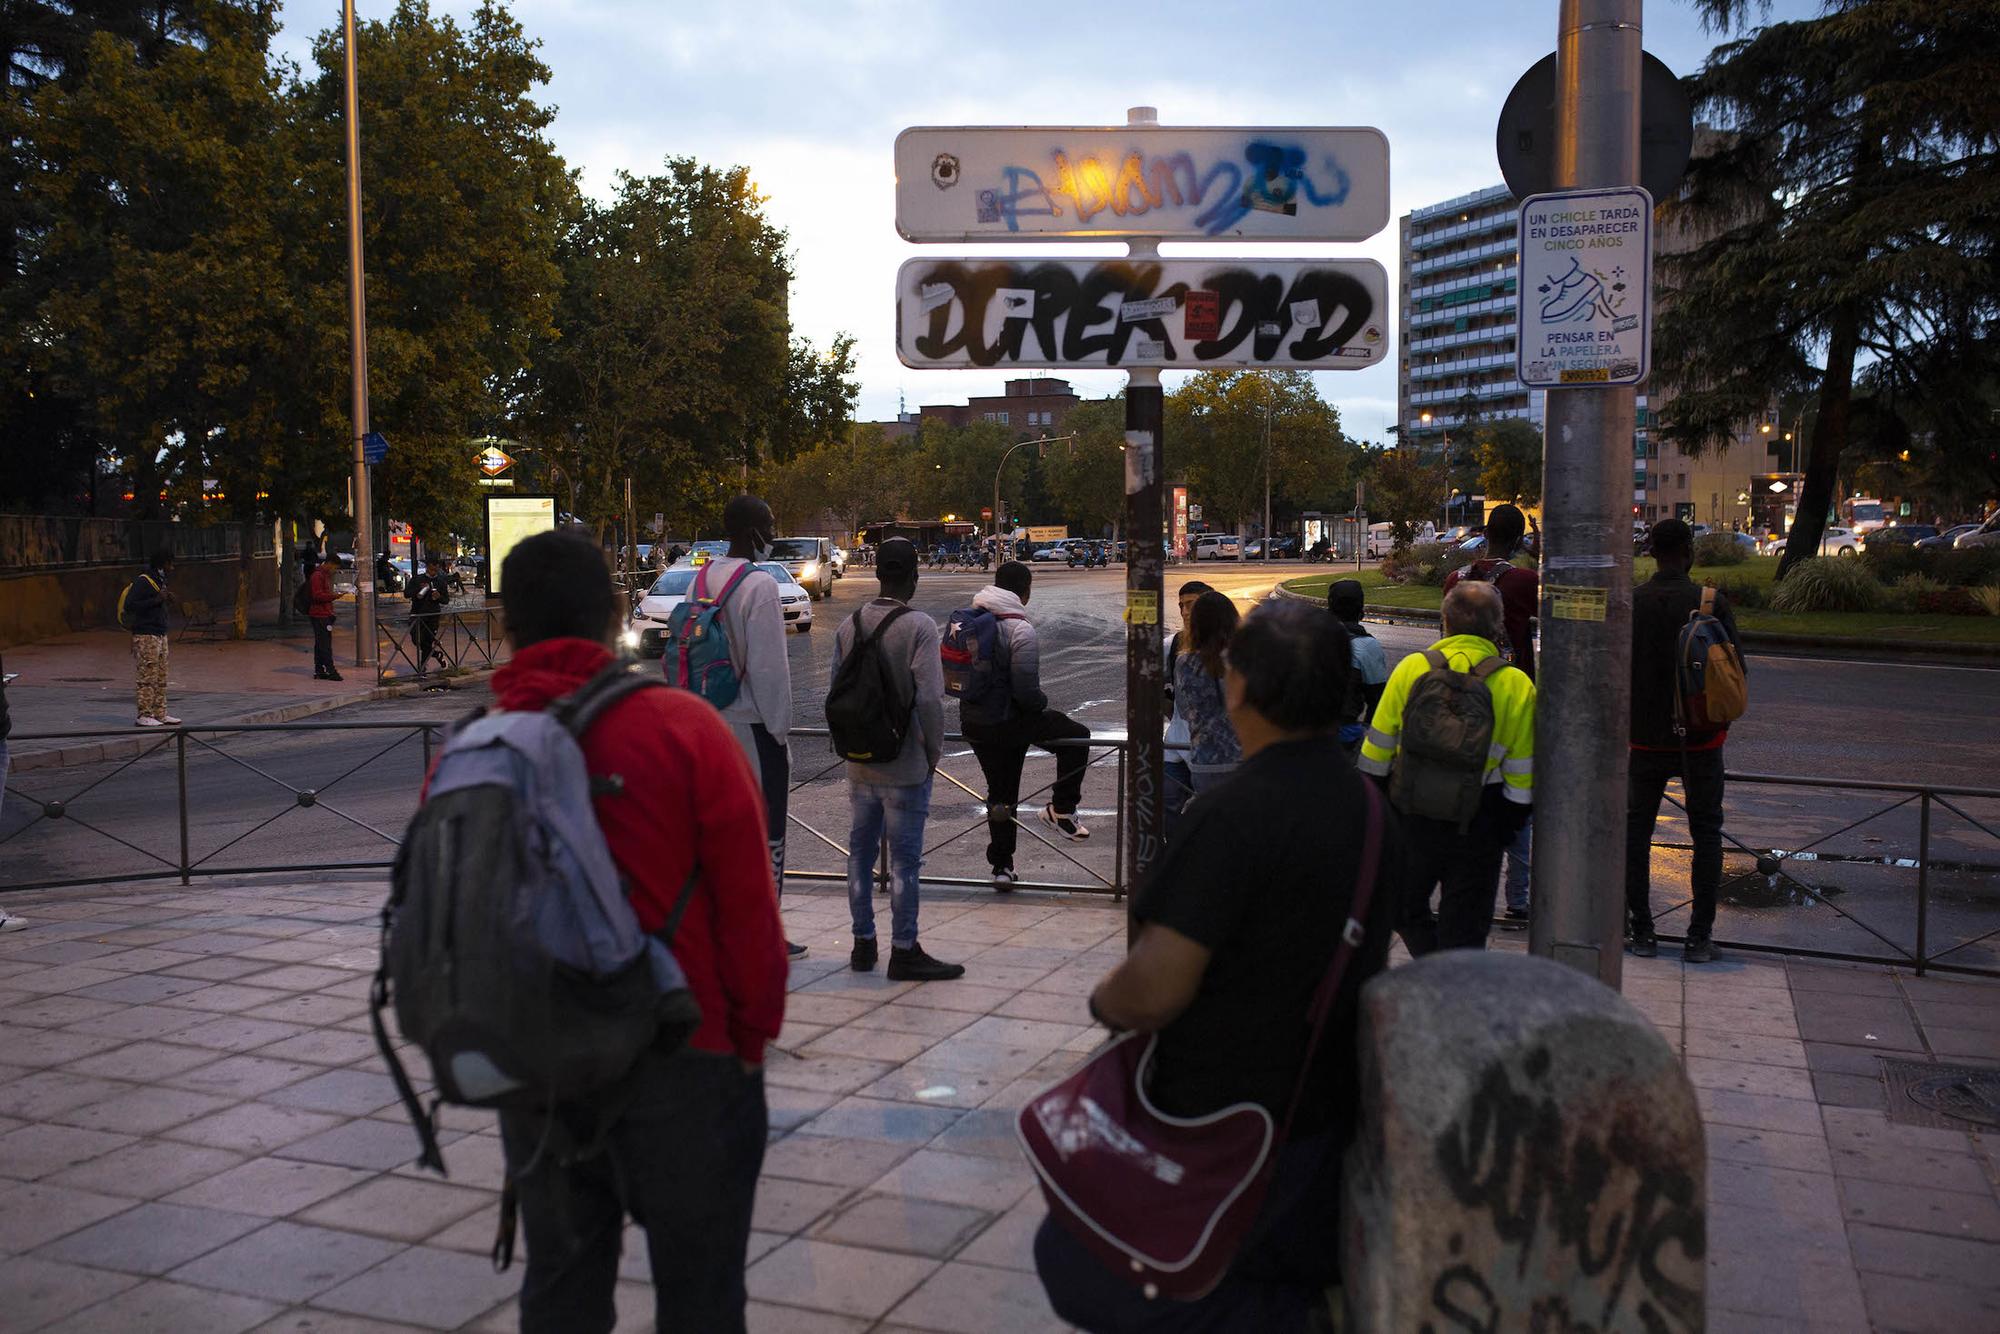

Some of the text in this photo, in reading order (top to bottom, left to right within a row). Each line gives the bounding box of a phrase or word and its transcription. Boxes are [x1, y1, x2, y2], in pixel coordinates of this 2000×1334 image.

[1530, 207, 1640, 225] UN CHICLE TARDA
[1531, 222, 1639, 238] EN DESAPARECER
[1544, 235, 1623, 251] CINCO AÑOS
[1547, 331, 1615, 344] PENSAR EN
[1541, 344, 1621, 357] LA PAPELERA
